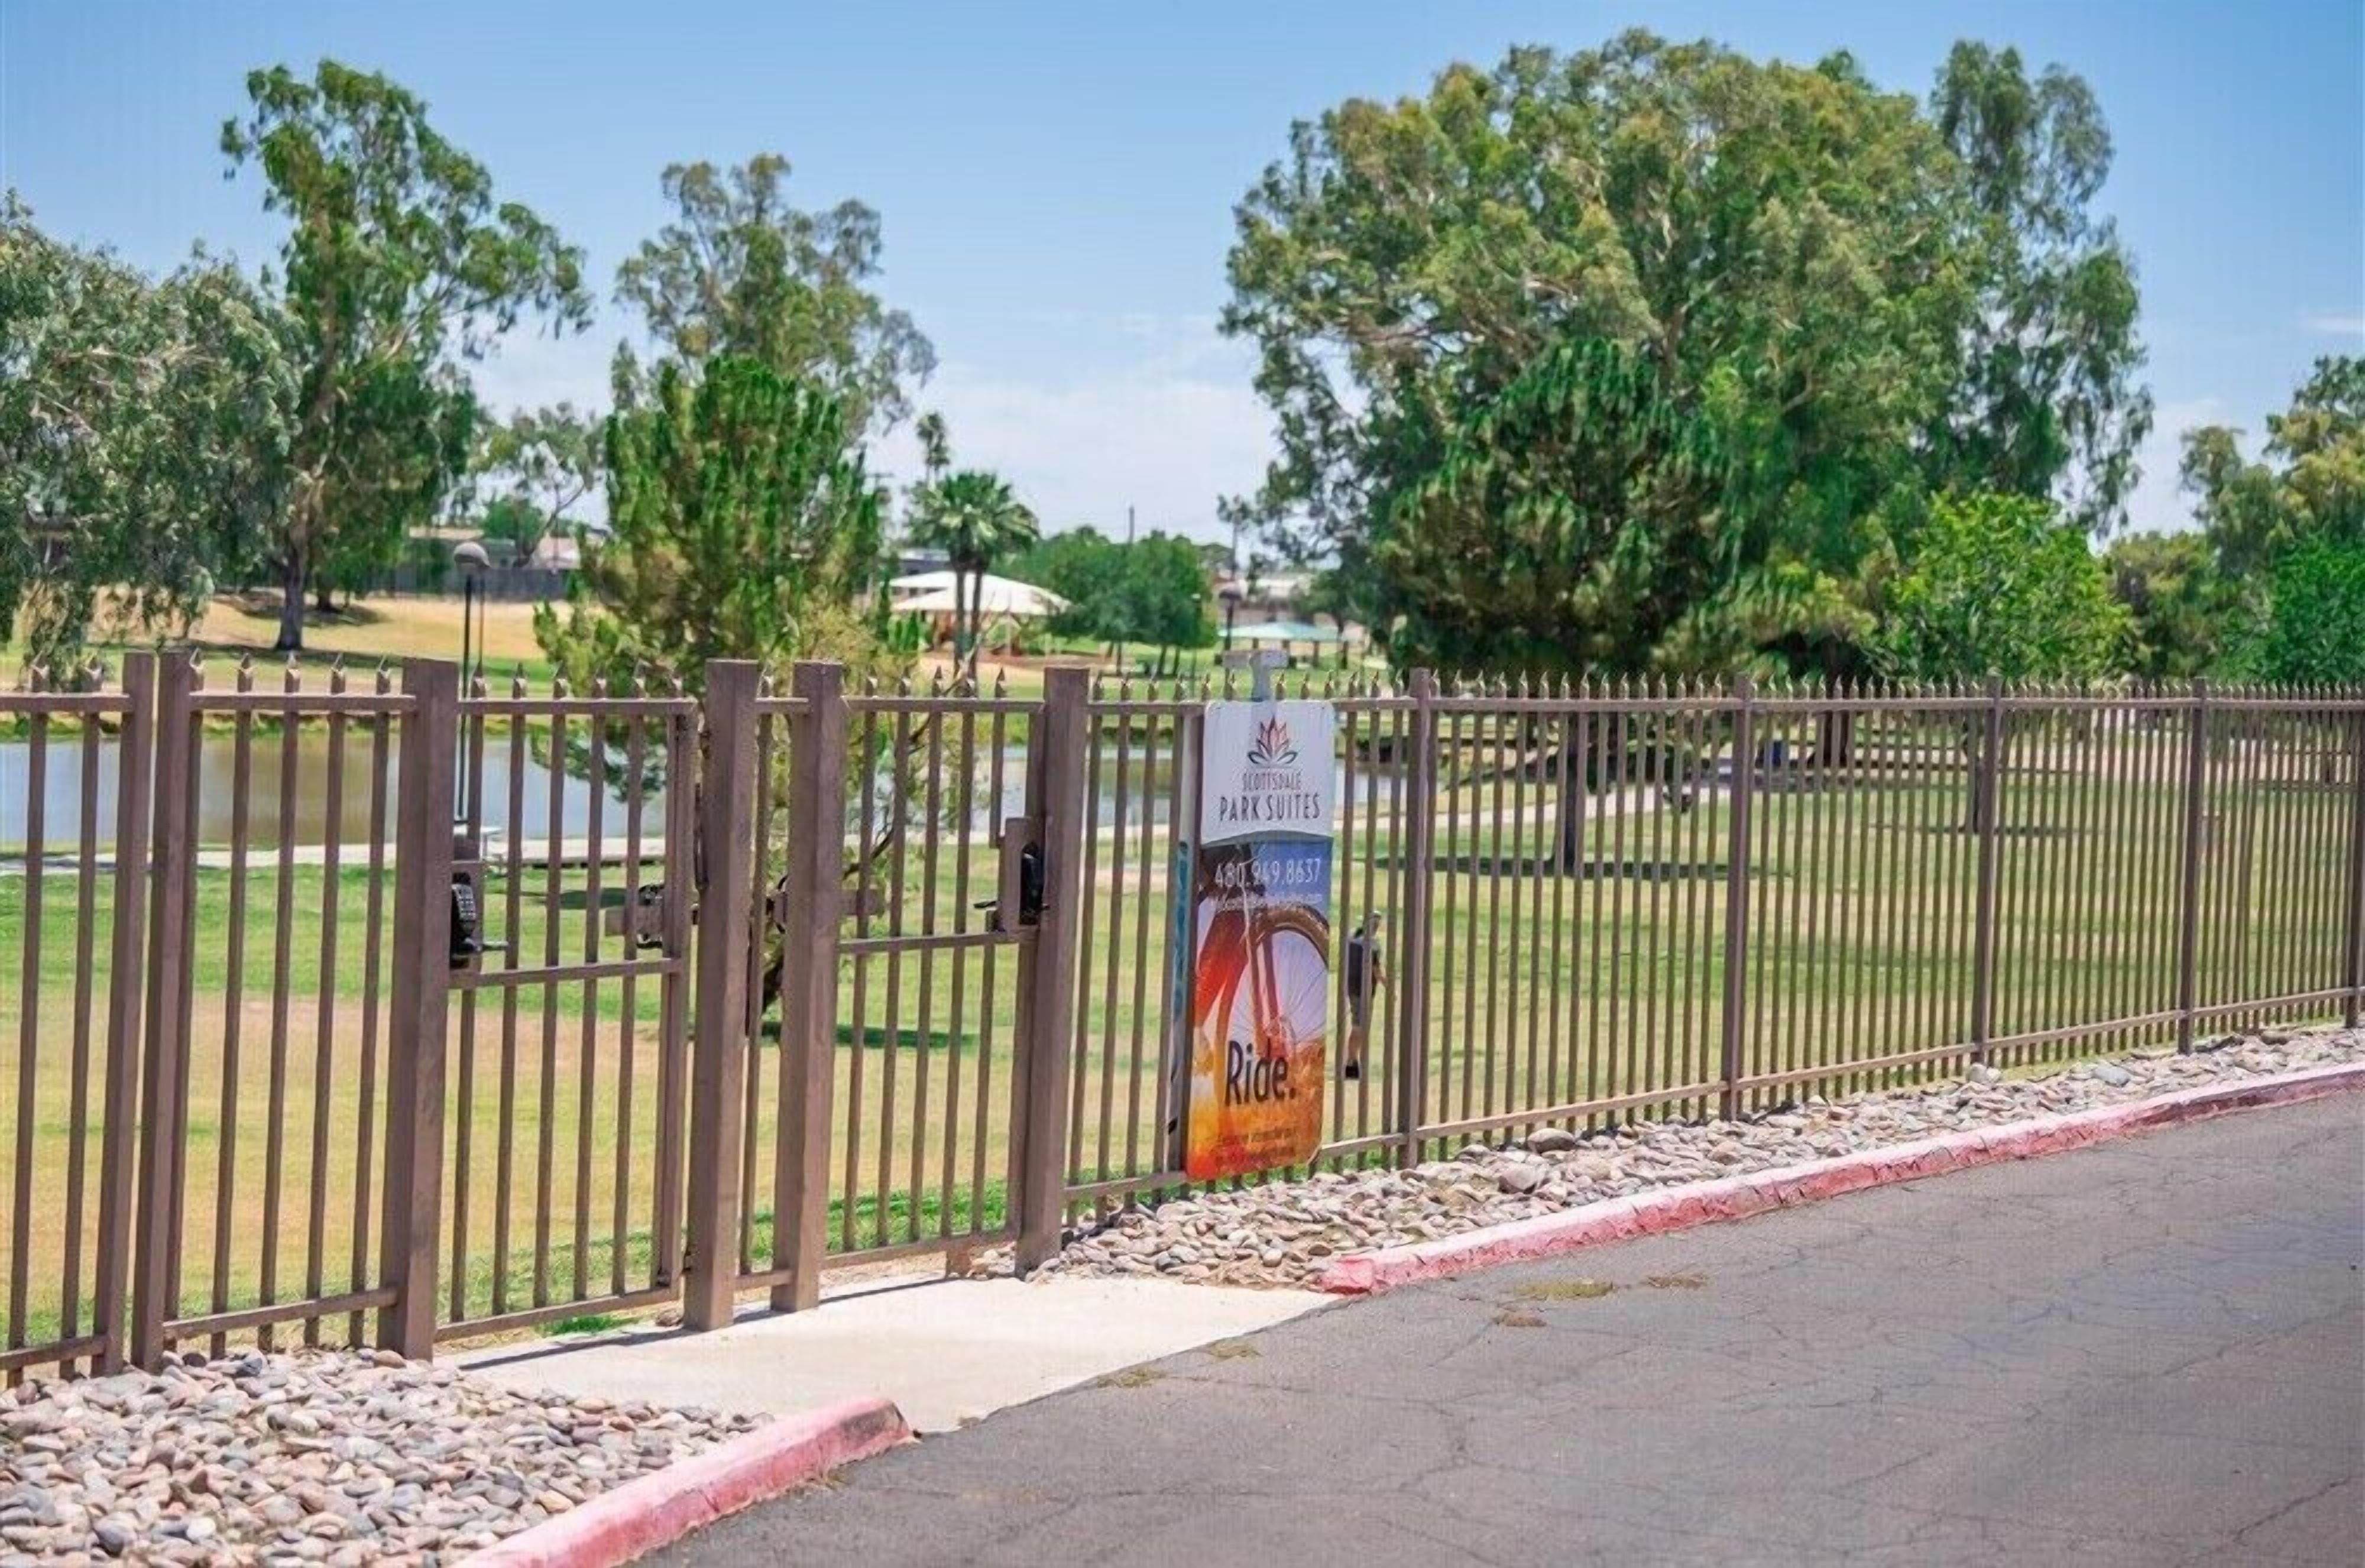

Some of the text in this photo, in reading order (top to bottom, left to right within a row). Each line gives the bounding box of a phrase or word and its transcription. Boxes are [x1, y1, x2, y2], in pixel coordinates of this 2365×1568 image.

[1242, 770, 1302, 791] SCOTTSDALE
[1220, 793, 1320, 821] PARK SUITES
[1224, 1038, 1297, 1106] Ride.
